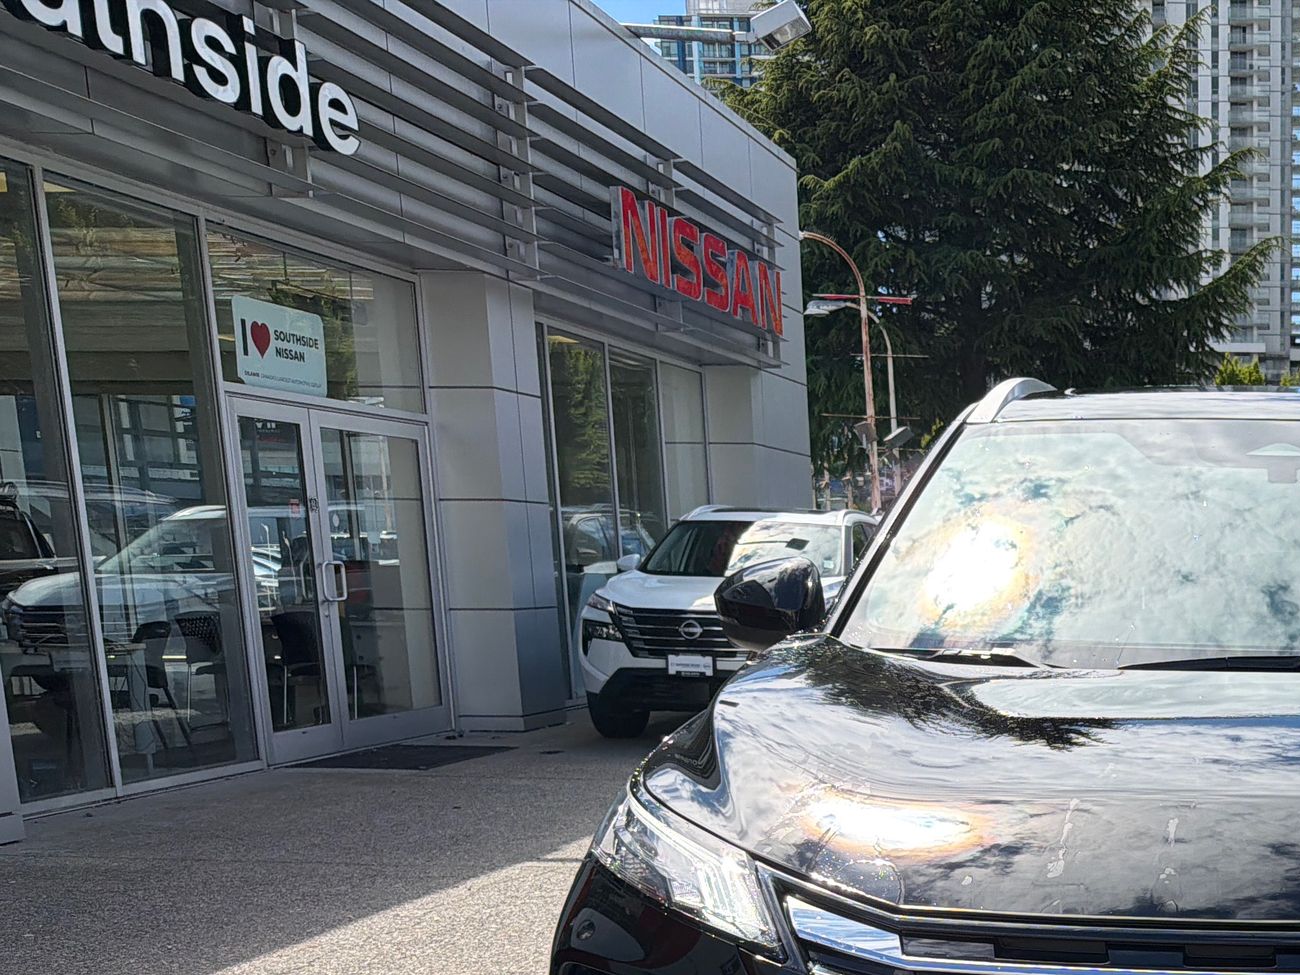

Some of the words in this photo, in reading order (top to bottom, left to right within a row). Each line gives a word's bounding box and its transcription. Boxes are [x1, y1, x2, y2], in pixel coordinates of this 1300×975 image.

[620, 186, 784, 337] NISSAN
[241, 318, 249, 357] I
[273, 329, 320, 350] SOUTHSIDE
[275, 346, 306, 363] NISSAN
